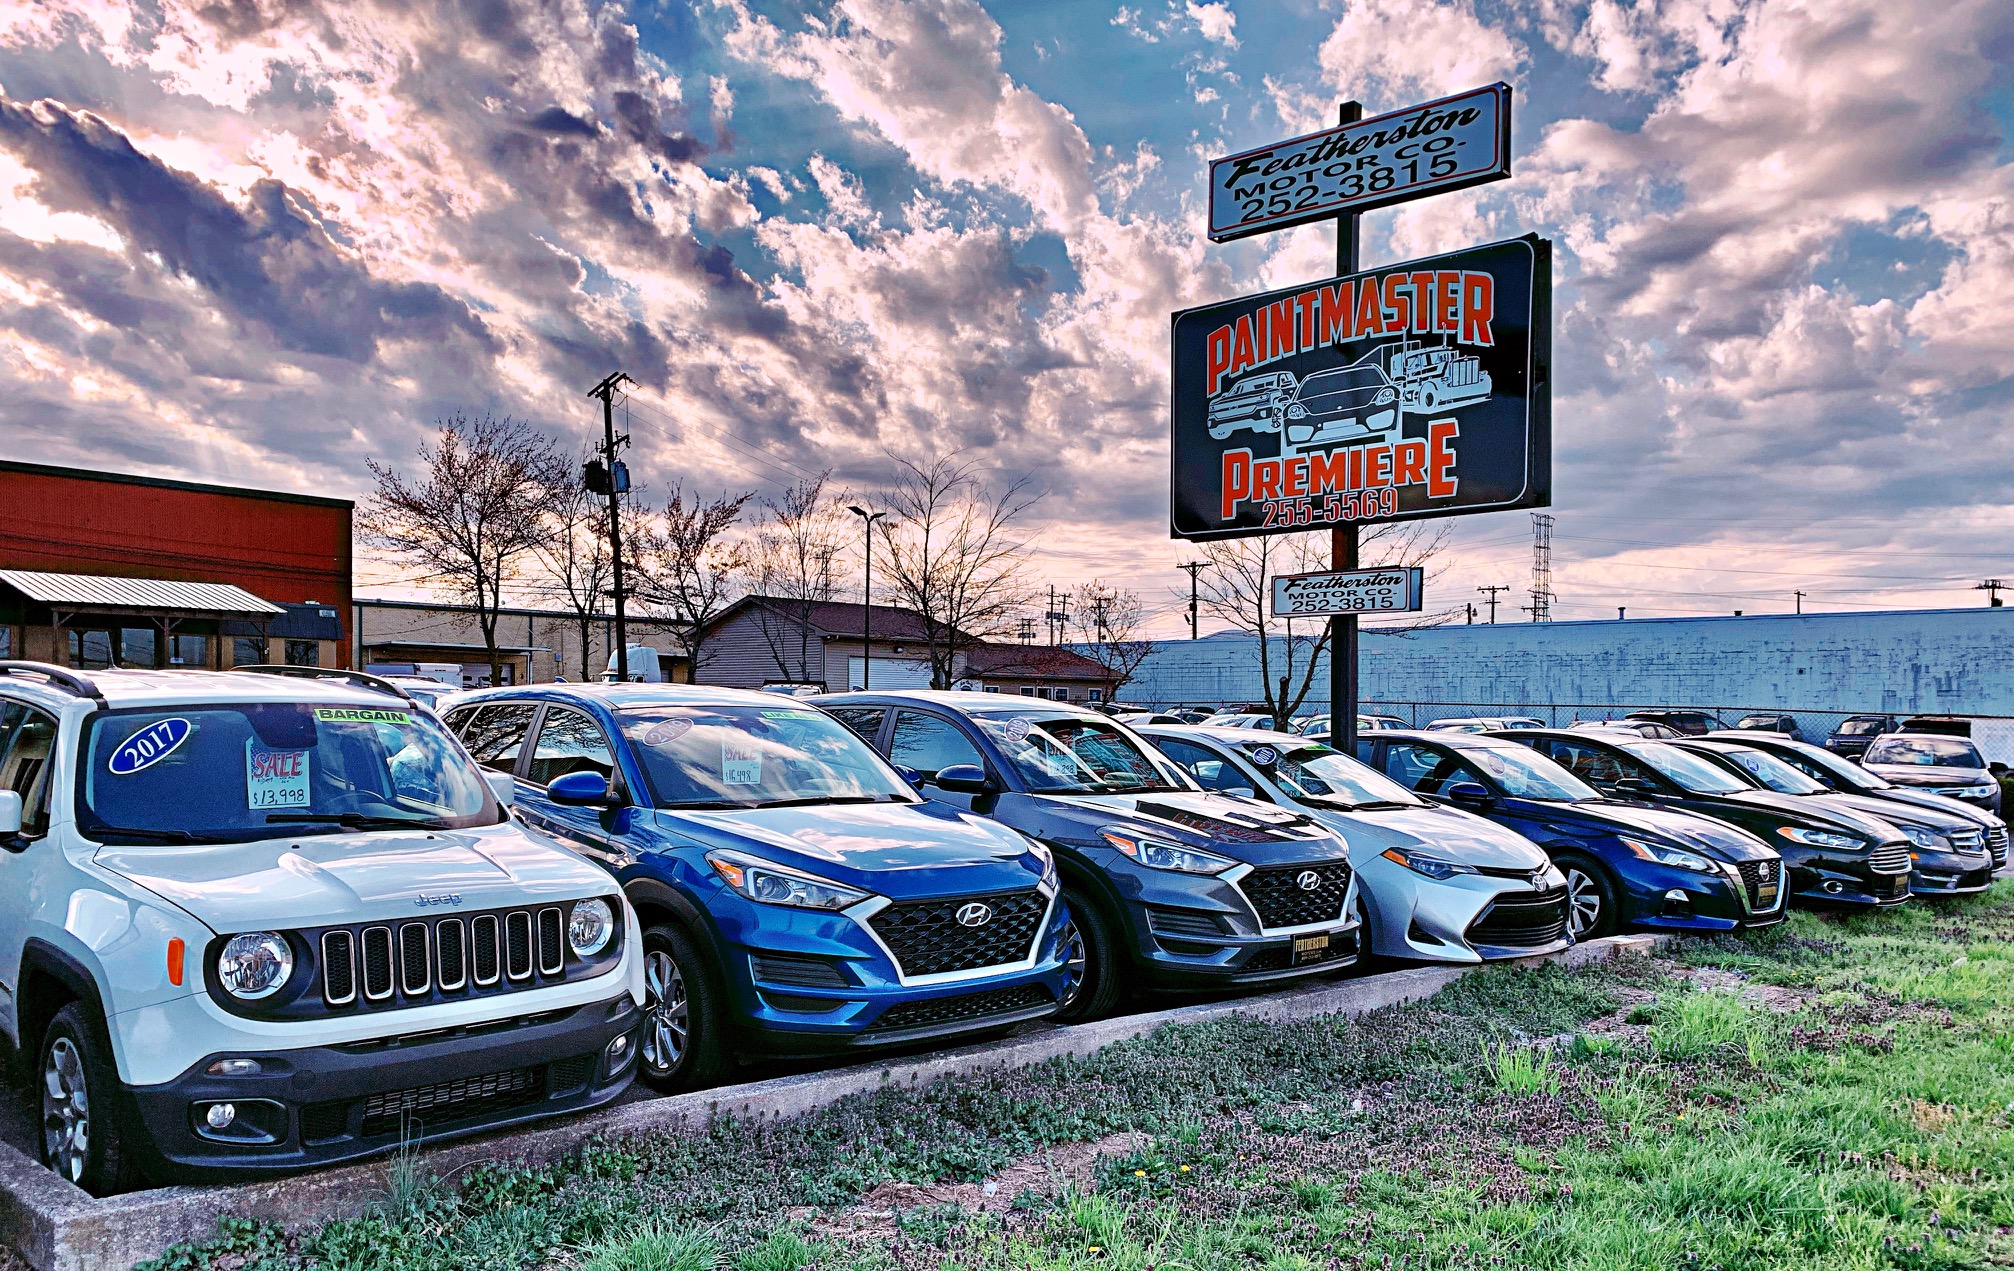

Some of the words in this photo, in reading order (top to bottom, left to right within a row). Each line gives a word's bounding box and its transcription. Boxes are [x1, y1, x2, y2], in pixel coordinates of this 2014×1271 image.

[1223, 106, 1482, 190] Featherston
[1233, 154, 1382, 201] MOTOR
[1239, 151, 1458, 224] 252-3815
[1206, 269, 1496, 399] PAINTMASTER
[1221, 417, 1460, 521] PREMIERE
[1261, 487, 1399, 529] 255-5569
[1283, 573, 1404, 593] Featherston
[1288, 589, 1359, 600] MOTOR
[1291, 595, 1394, 612] 252-3815
[318, 709, 405, 722] BARGAIN
[124, 721, 176, 768] 2017
[650, 719, 690, 744] 2019
[253, 751, 305, 778] SALE
[253, 788, 305, 806] $13,998
[413, 893, 463, 907] Jeep
